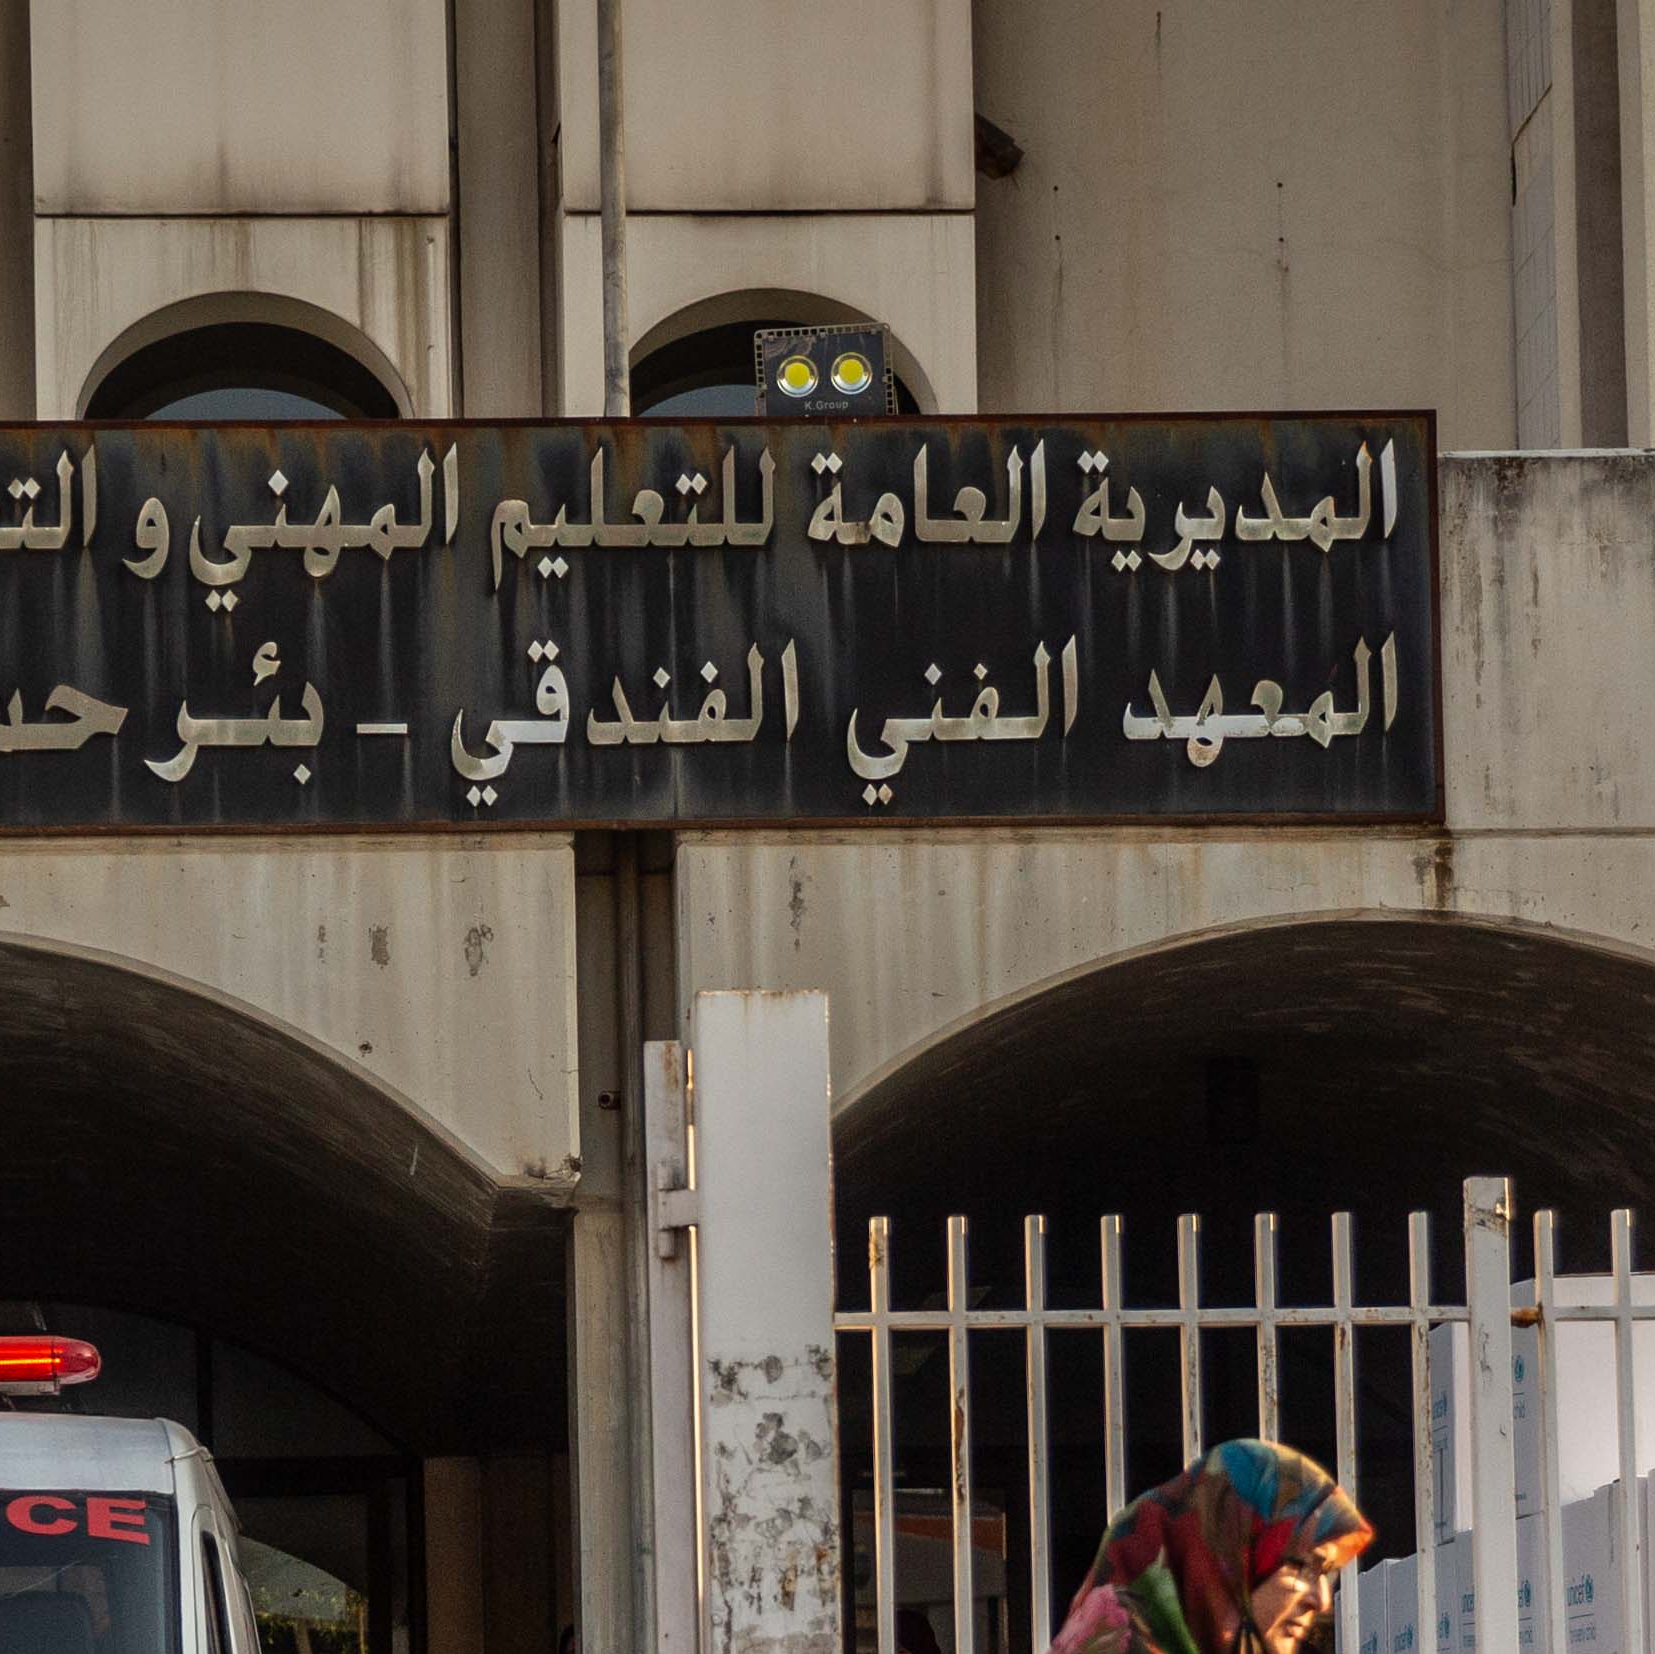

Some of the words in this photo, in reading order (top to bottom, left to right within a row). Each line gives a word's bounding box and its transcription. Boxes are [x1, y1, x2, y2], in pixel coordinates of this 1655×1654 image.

[804, 400, 849, 411] K.Group
[122, 497, 170, 580] و
[189, 441, 458, 613] المهني
[490, 446, 776, 592] للتعليم
[807, 438, 1047, 548] العامة
[1073, 438, 1398, 573] المديرية
[144, 641, 325, 785] بئر
[451, 638, 800, 807] الفندقي
[847, 634, 1079, 806] الفني
[1123, 630, 1398, 768] المعهد
